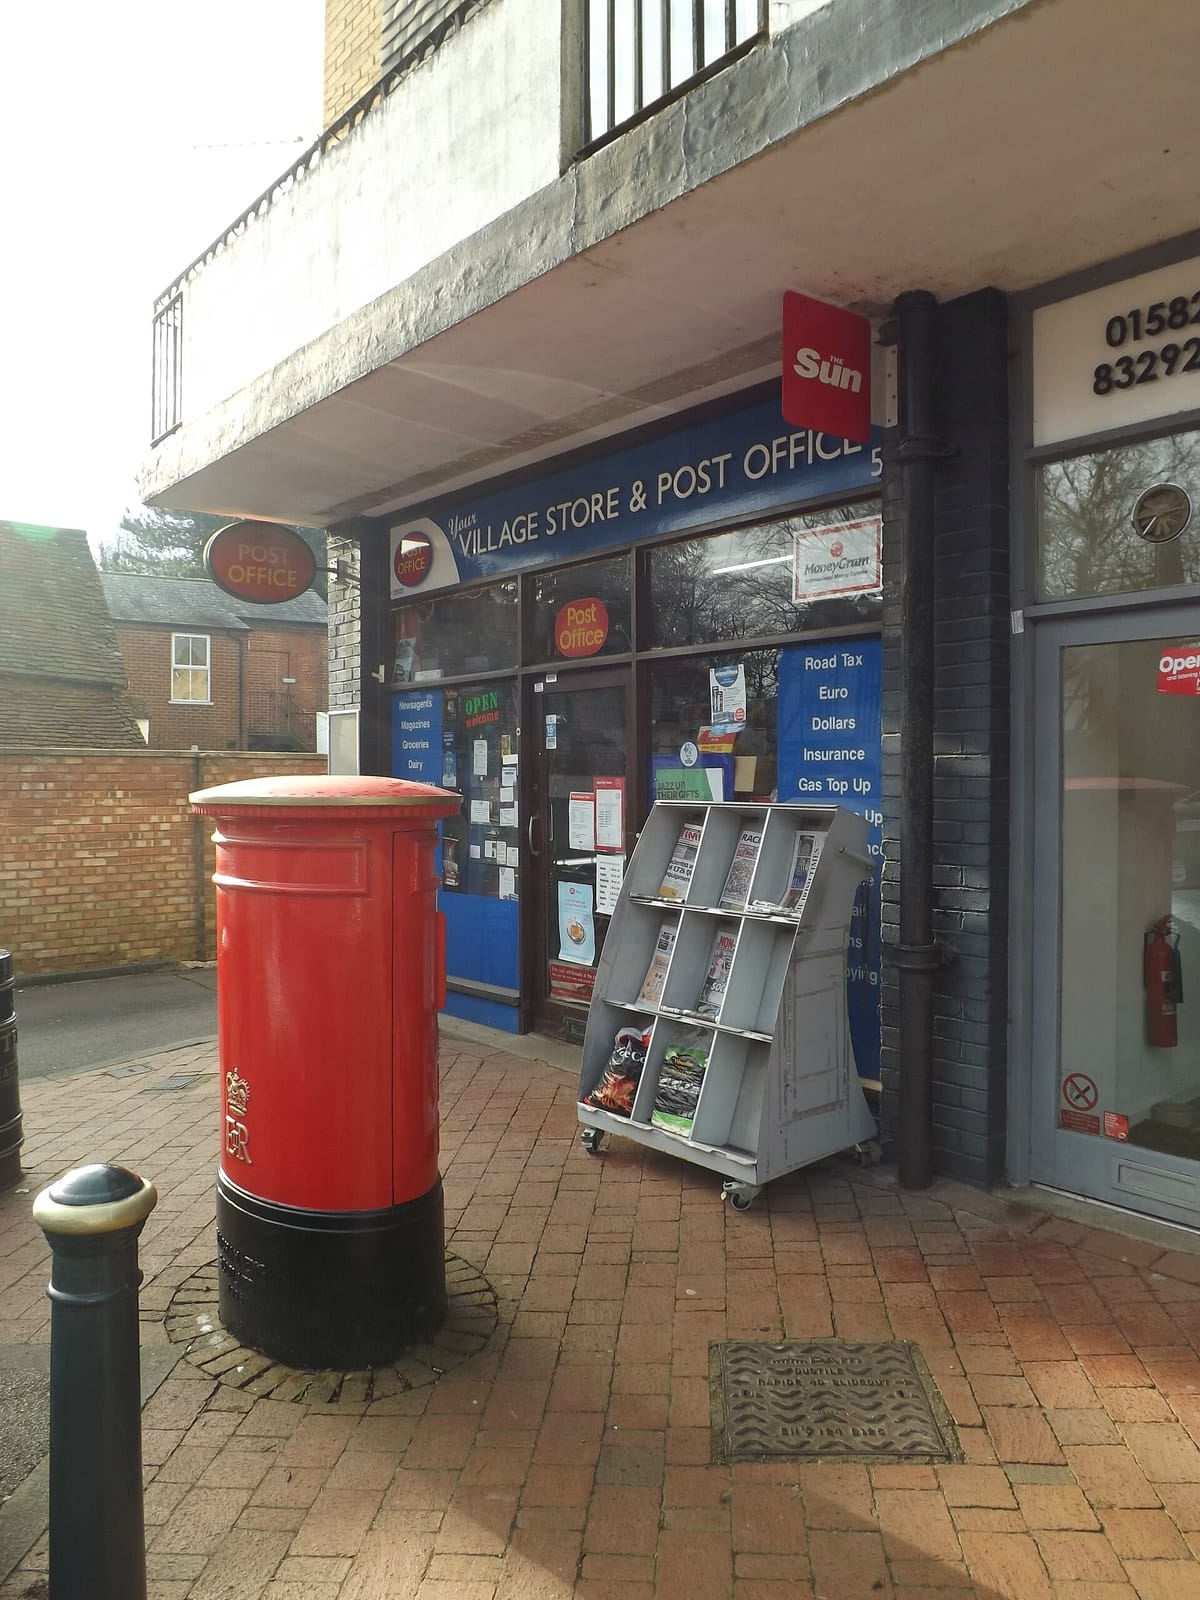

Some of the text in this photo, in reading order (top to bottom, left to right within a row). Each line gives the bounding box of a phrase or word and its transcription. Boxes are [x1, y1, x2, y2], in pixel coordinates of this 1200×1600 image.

[793, 347, 862, 393] Sun
[1093, 337, 1200, 396] 83292
[459, 512, 539, 557] VILLAGE
[546, 487, 620, 536] STORE
[629, 480, 648, 513] &
[657, 453, 733, 505] POST
[448, 512, 478, 541] Your
[239, 544, 289, 566] POST
[398, 558, 425, 575] OFFICE
[228, 565, 297, 588] OFFICE
[567, 604, 597, 626] Post
[560, 628, 605, 650] Office
[805, 653, 864, 671] Road Tax
[819, 686, 848, 700] Euro
[398, 699, 433, 711] Newsagents
[465, 690, 499, 716] OPEN
[401, 720, 431, 732] Magazines
[465, 710, 500, 729] welcome
[812, 716, 856, 731] Dollars
[402, 739, 430, 750] Groceries
[803, 748, 865, 761] Insurance
[408, 759, 424, 771] Dairy
[657, 781, 686, 790] JAZZ UP
[799, 778, 872, 795] Gas Top Up
[656, 789, 700, 800] THEIR GIFTS
[864, 809, 883, 827] Up
[741, 833, 761, 844] RAC
